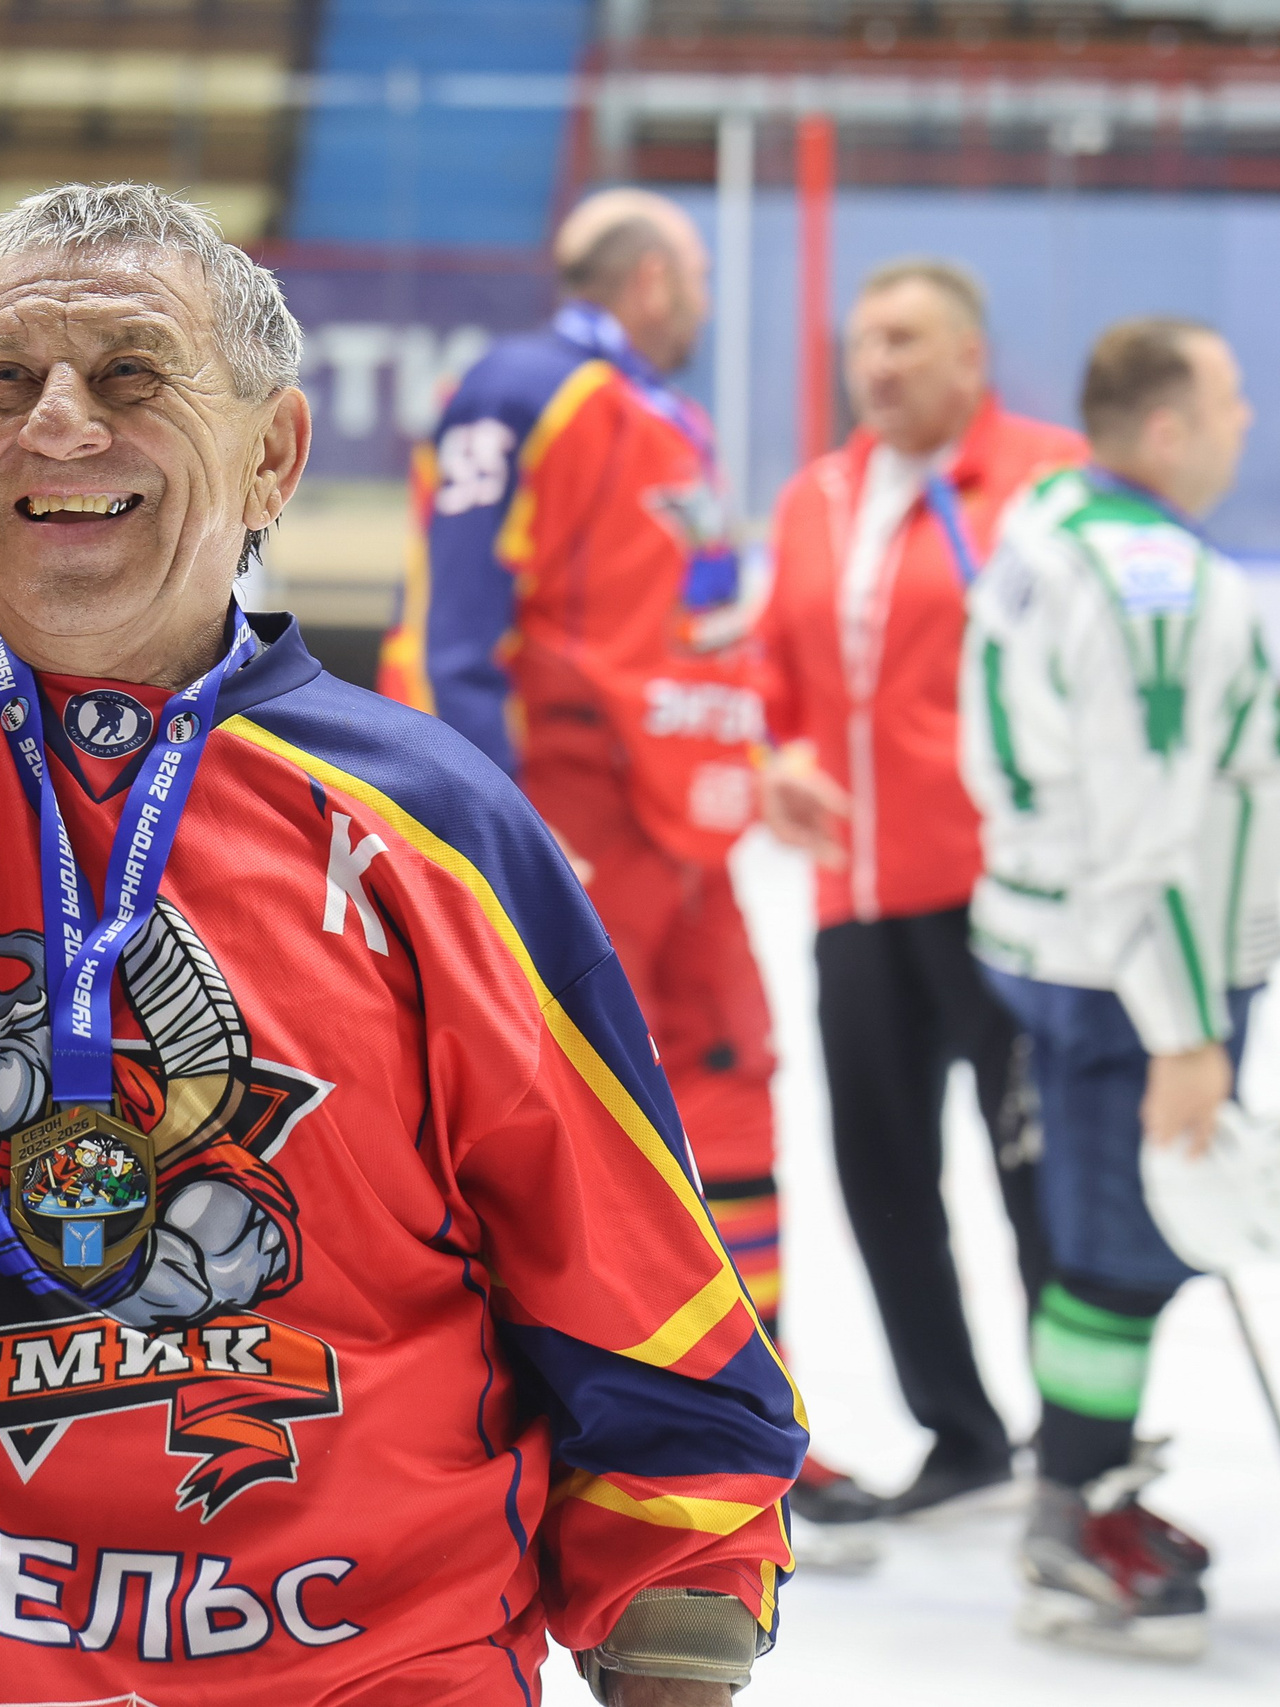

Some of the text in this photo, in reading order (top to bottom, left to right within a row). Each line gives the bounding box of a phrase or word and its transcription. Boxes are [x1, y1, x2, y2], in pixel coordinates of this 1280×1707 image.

[89, 694, 134, 707] ОЧНАЯ
[18, 737, 43, 785] 026
[72, 750, 182, 1039] КУБОК ГУБЕРНАТОРА 2026
[18, 1117, 90, 1160] 2025-2026
[21, 1117, 63, 1145] СЕЗОН
